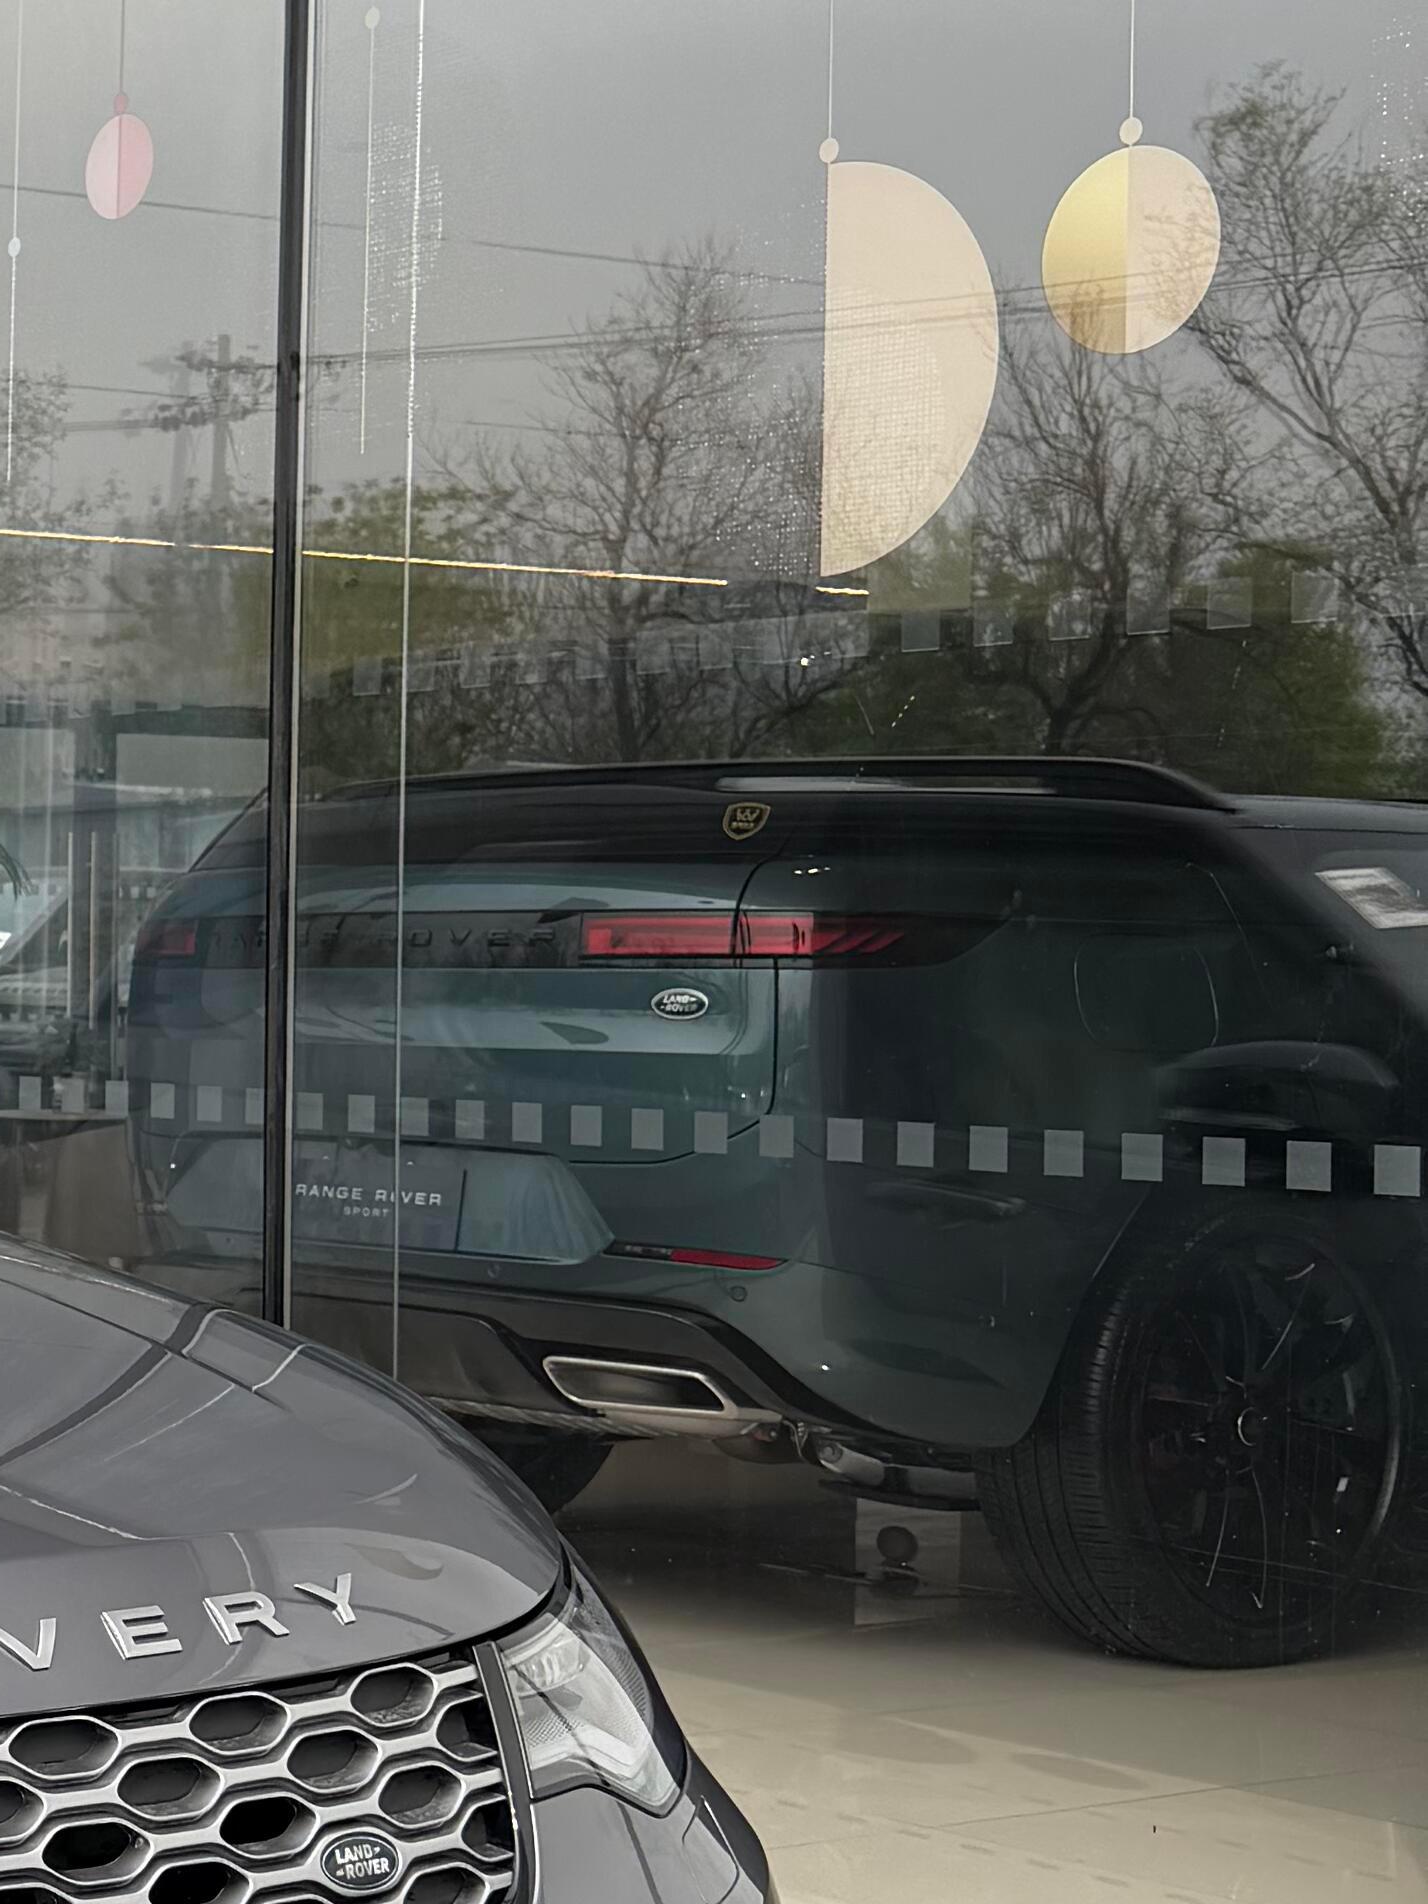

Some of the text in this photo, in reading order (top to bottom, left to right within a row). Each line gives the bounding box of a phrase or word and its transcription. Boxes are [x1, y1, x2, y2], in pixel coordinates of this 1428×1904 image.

[663, 995, 690, 1004] LAND
[295, 1183, 364, 1201] RANGE
[343, 1206, 389, 1217] SPORT
[334, 1843, 373, 1865] LAND
[344, 1856, 390, 1880] ROVER
